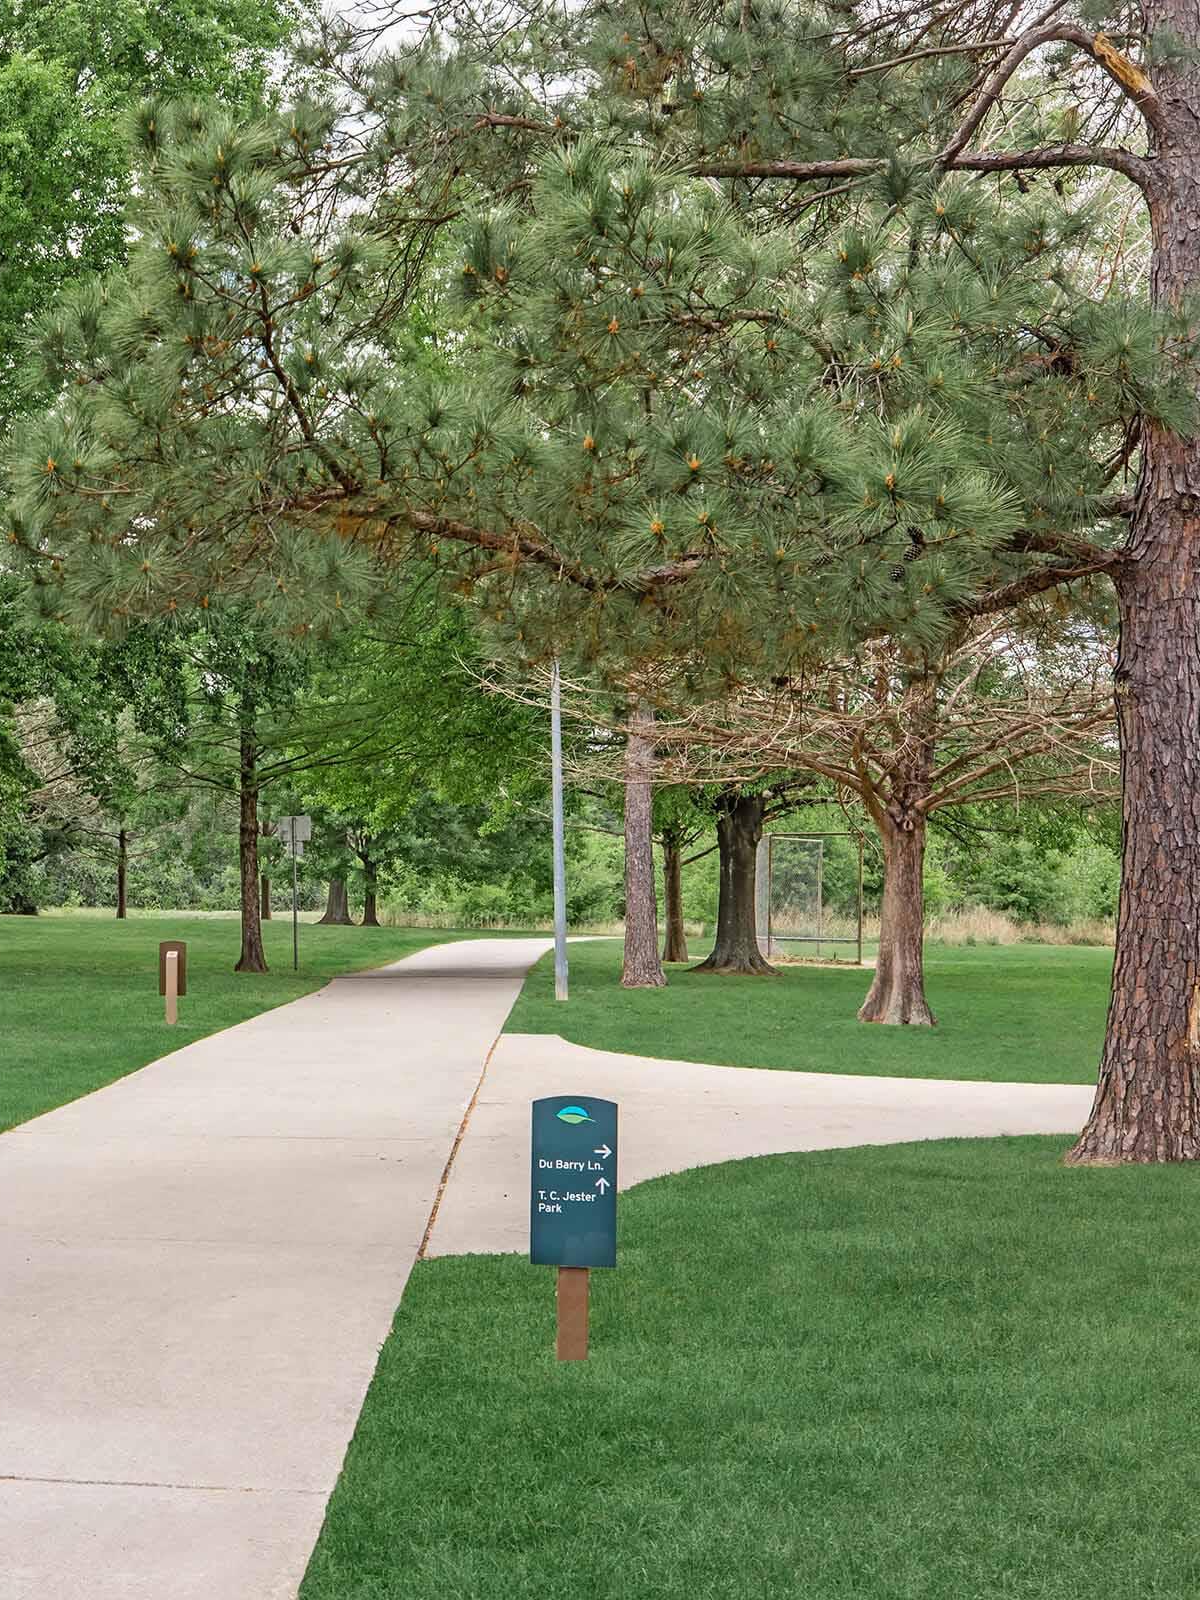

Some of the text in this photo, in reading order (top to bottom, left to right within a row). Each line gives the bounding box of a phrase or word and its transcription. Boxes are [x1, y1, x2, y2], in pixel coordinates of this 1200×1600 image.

[538, 1159, 604, 1172] Du Barry Ln.
[538, 1190, 597, 1202] T. C. Jester
[538, 1203, 562, 1213] Park
